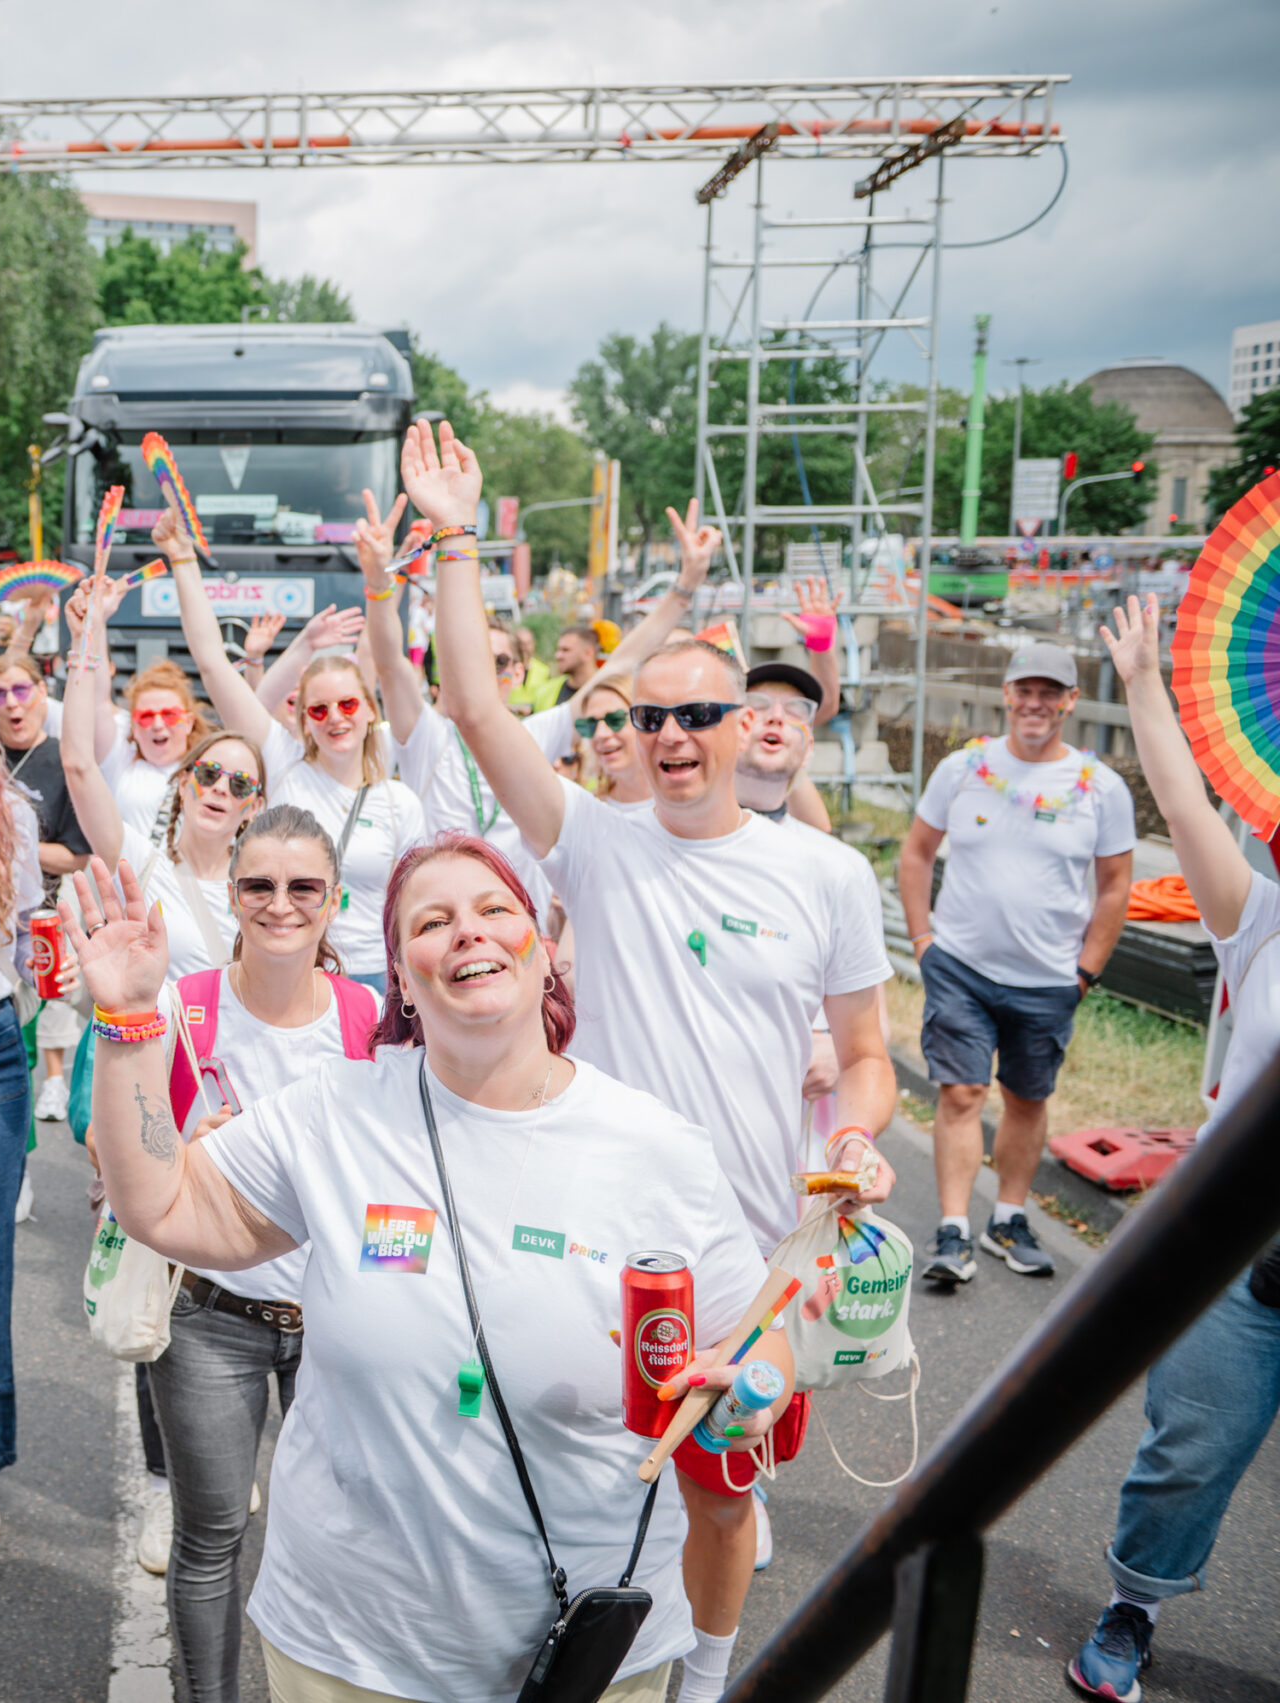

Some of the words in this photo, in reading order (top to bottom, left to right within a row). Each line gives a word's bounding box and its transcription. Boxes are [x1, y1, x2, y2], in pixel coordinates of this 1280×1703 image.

[380, 1219, 416, 1232] LEBE
[368, 1232, 393, 1244] WIE
[404, 1232, 427, 1246] DU
[378, 1244, 414, 1257] BIST
[521, 1233, 556, 1249] DEVK
[569, 1242, 608, 1264] PRIDE
[837, 1299, 894, 1320] stark.
[640, 1339, 688, 1353] Reissdorf
[648, 1353, 683, 1366] Kölsch
